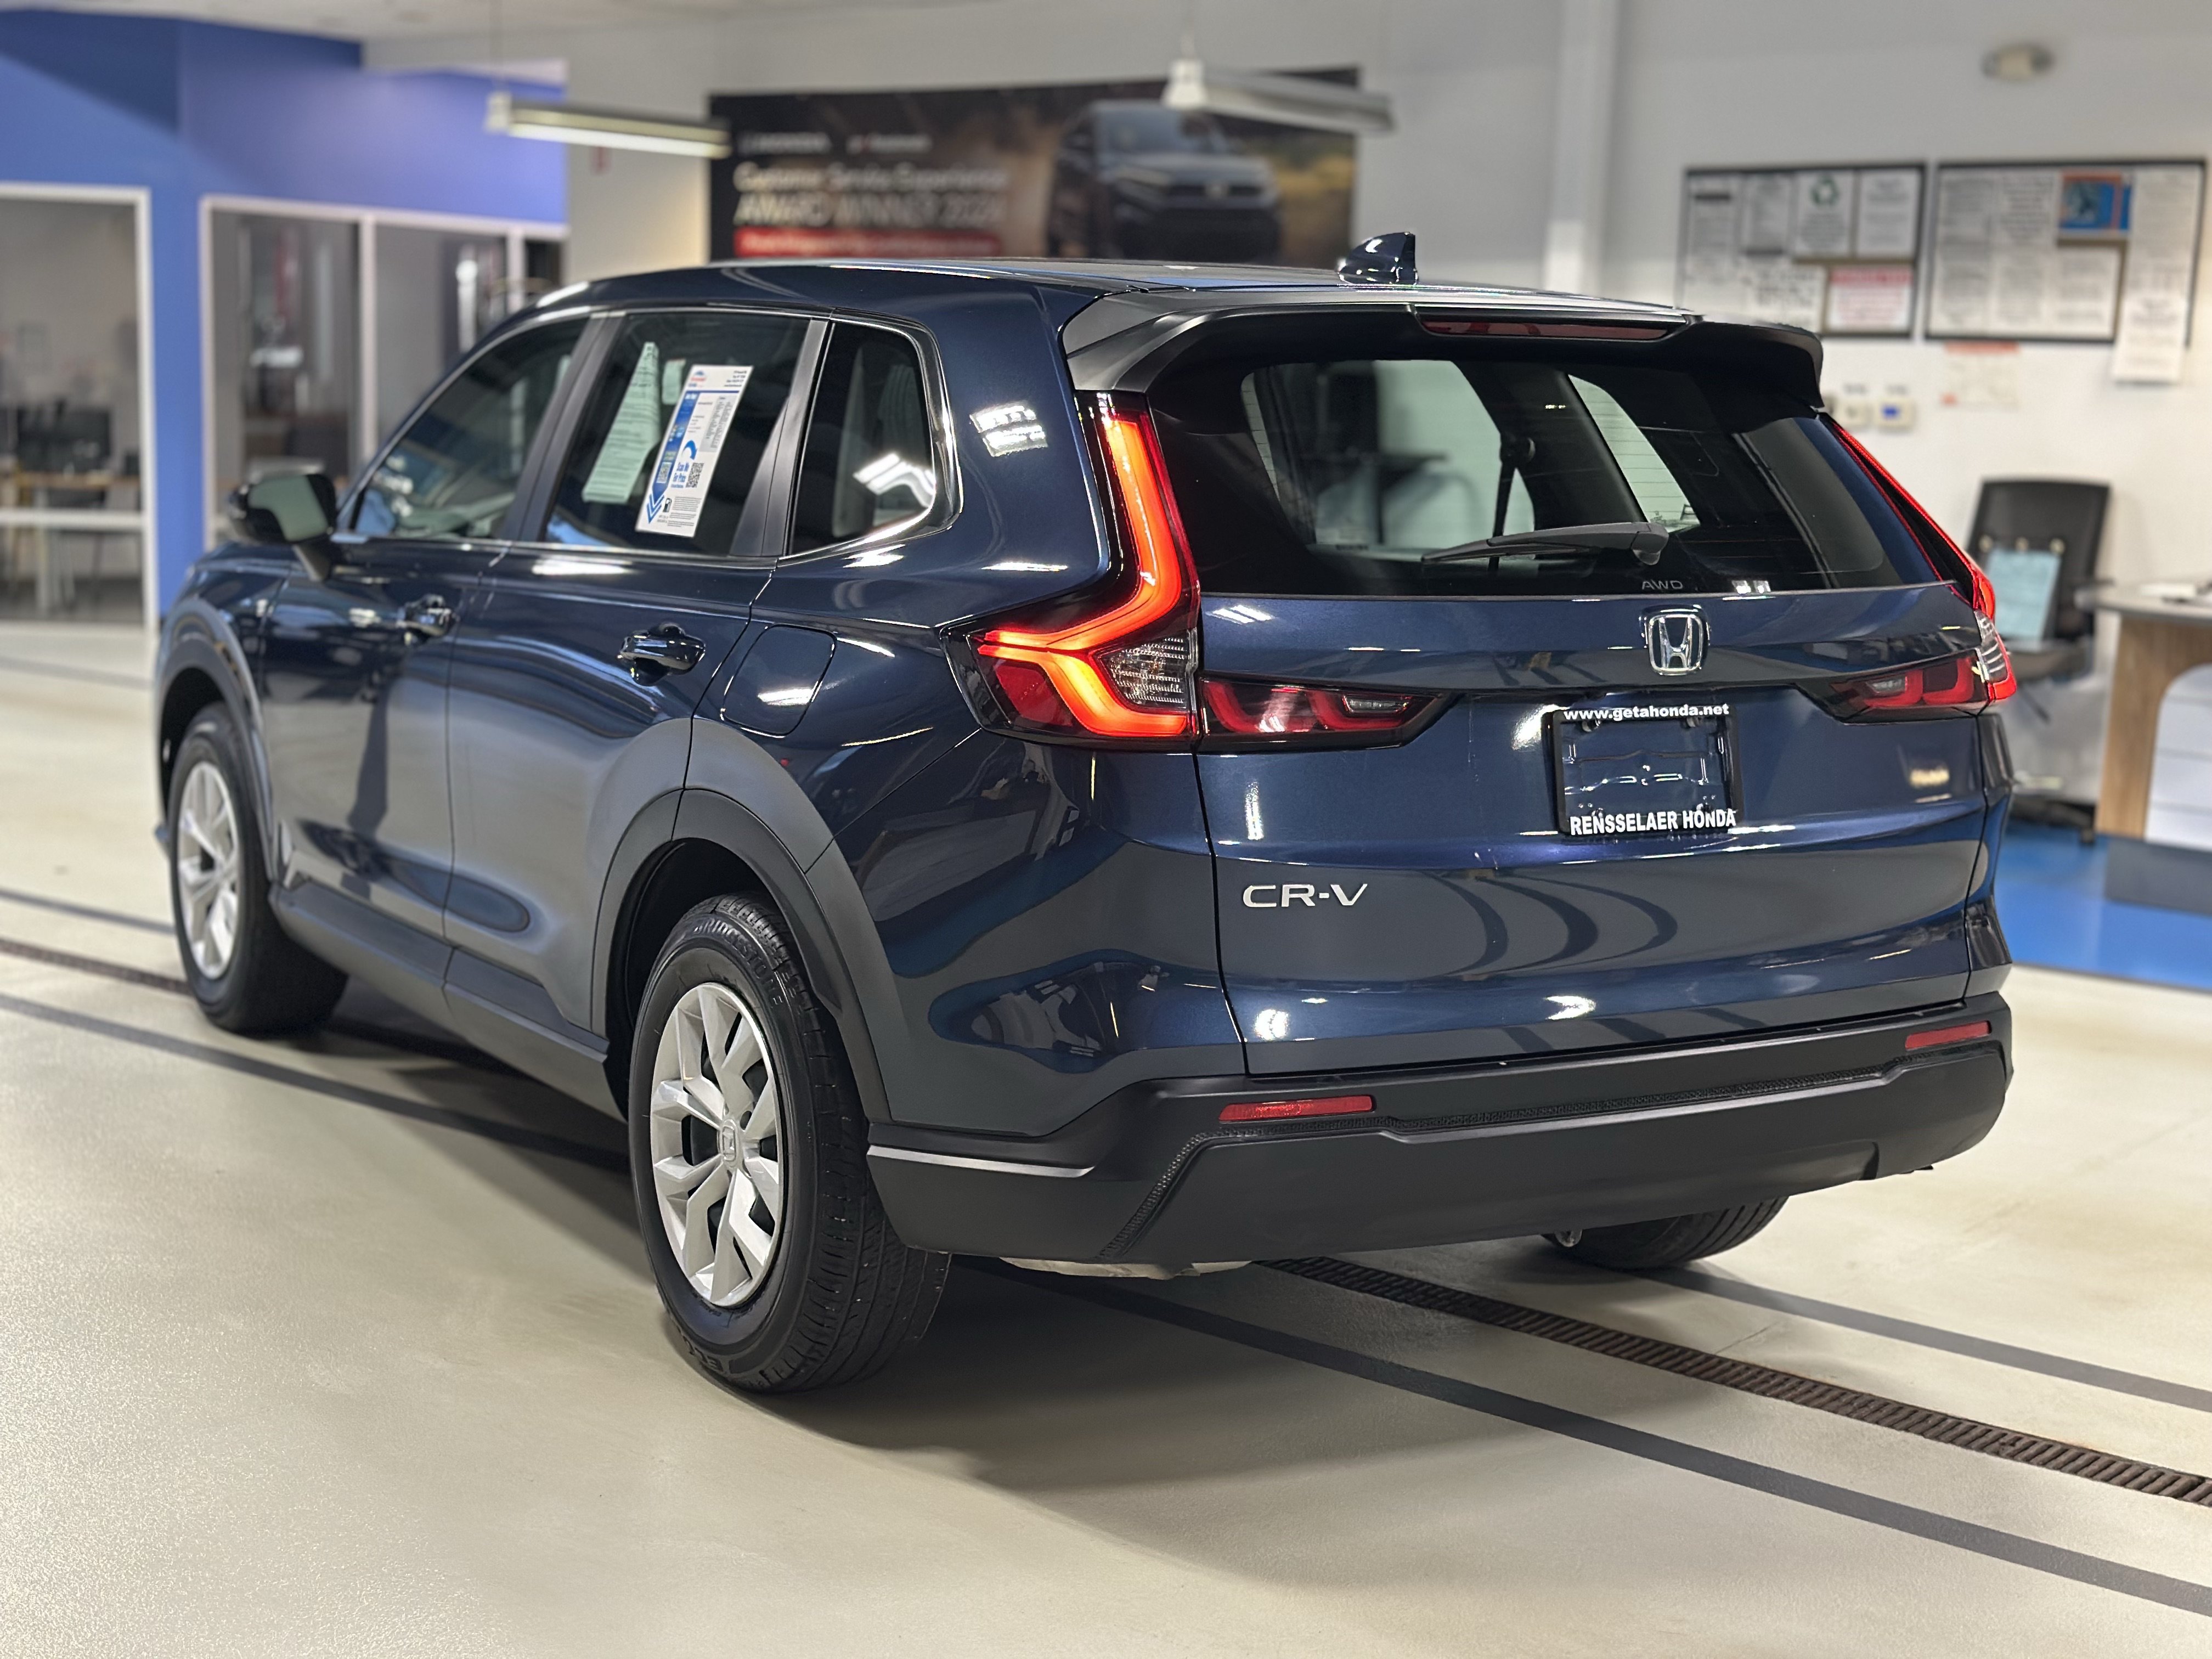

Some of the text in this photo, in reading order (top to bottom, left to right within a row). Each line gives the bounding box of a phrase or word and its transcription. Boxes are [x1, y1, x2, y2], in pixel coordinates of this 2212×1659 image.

[1641, 580, 1684, 590] AWD
[1563, 703, 1730, 721] www.getahonda.net
[1570, 808, 1736, 836] RENSSELAER HONDA
[1243, 883, 1368, 907] CR-V
